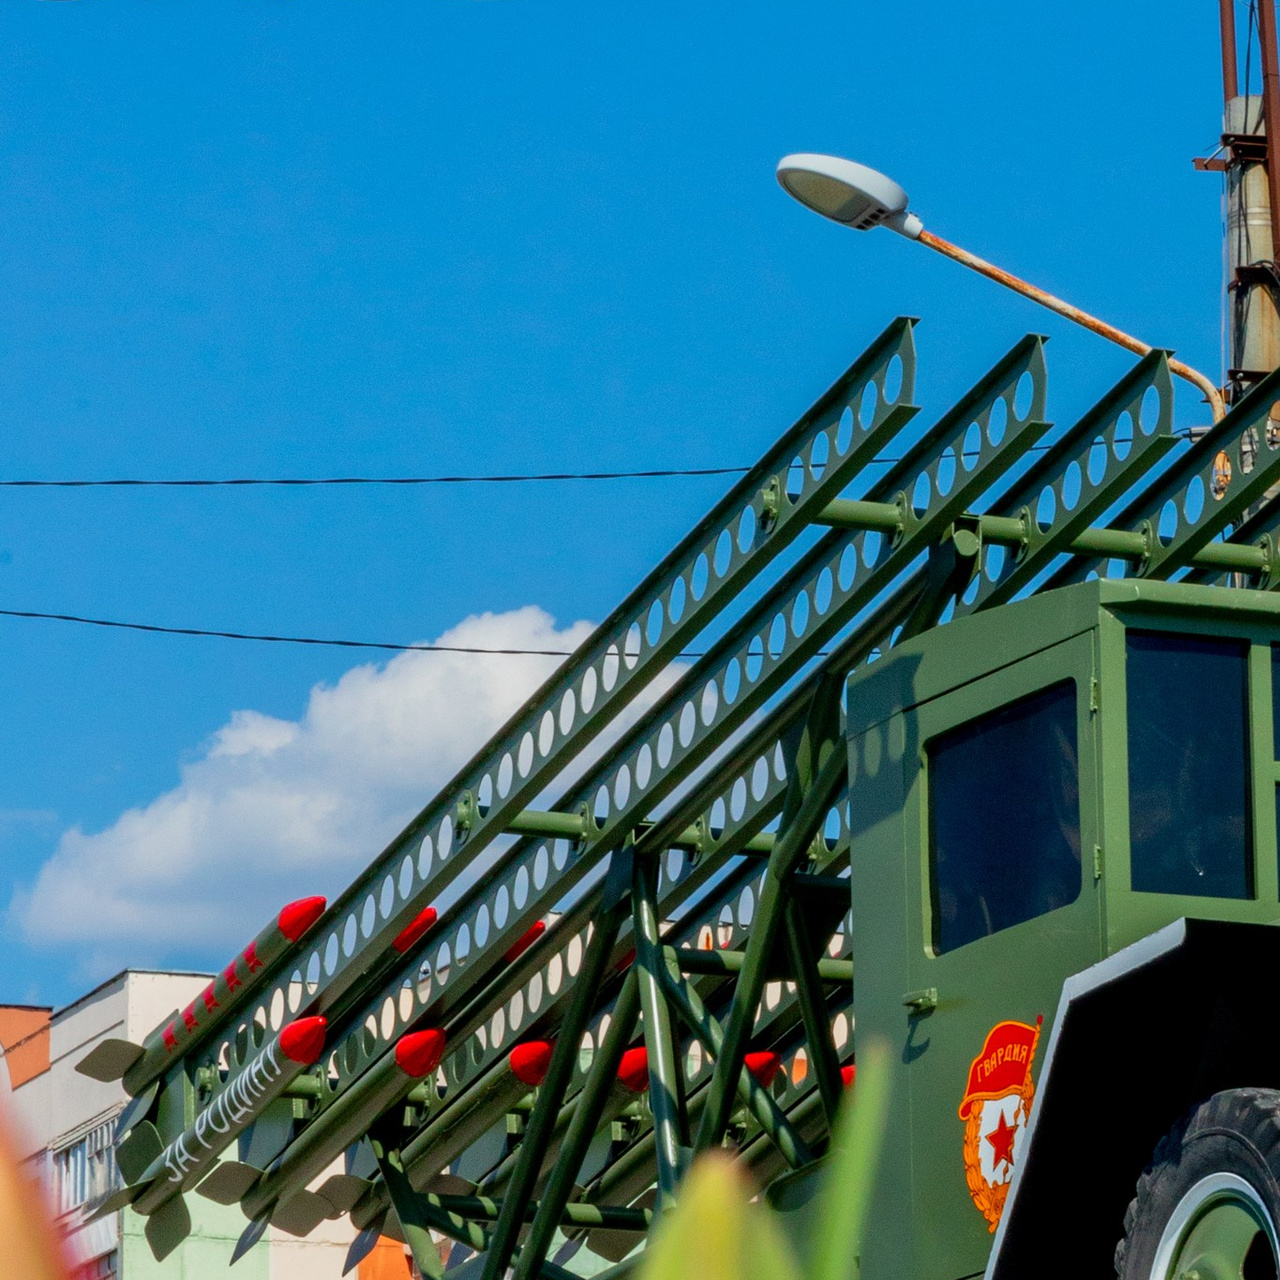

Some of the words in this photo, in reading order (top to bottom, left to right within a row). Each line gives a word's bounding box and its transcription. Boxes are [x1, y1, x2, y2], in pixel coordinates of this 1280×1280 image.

[977, 1043, 1029, 1083] ГВАРДИЯ
[162, 1132, 200, 1182] ЗА
[195, 1037, 281, 1150] РОДИНУ
